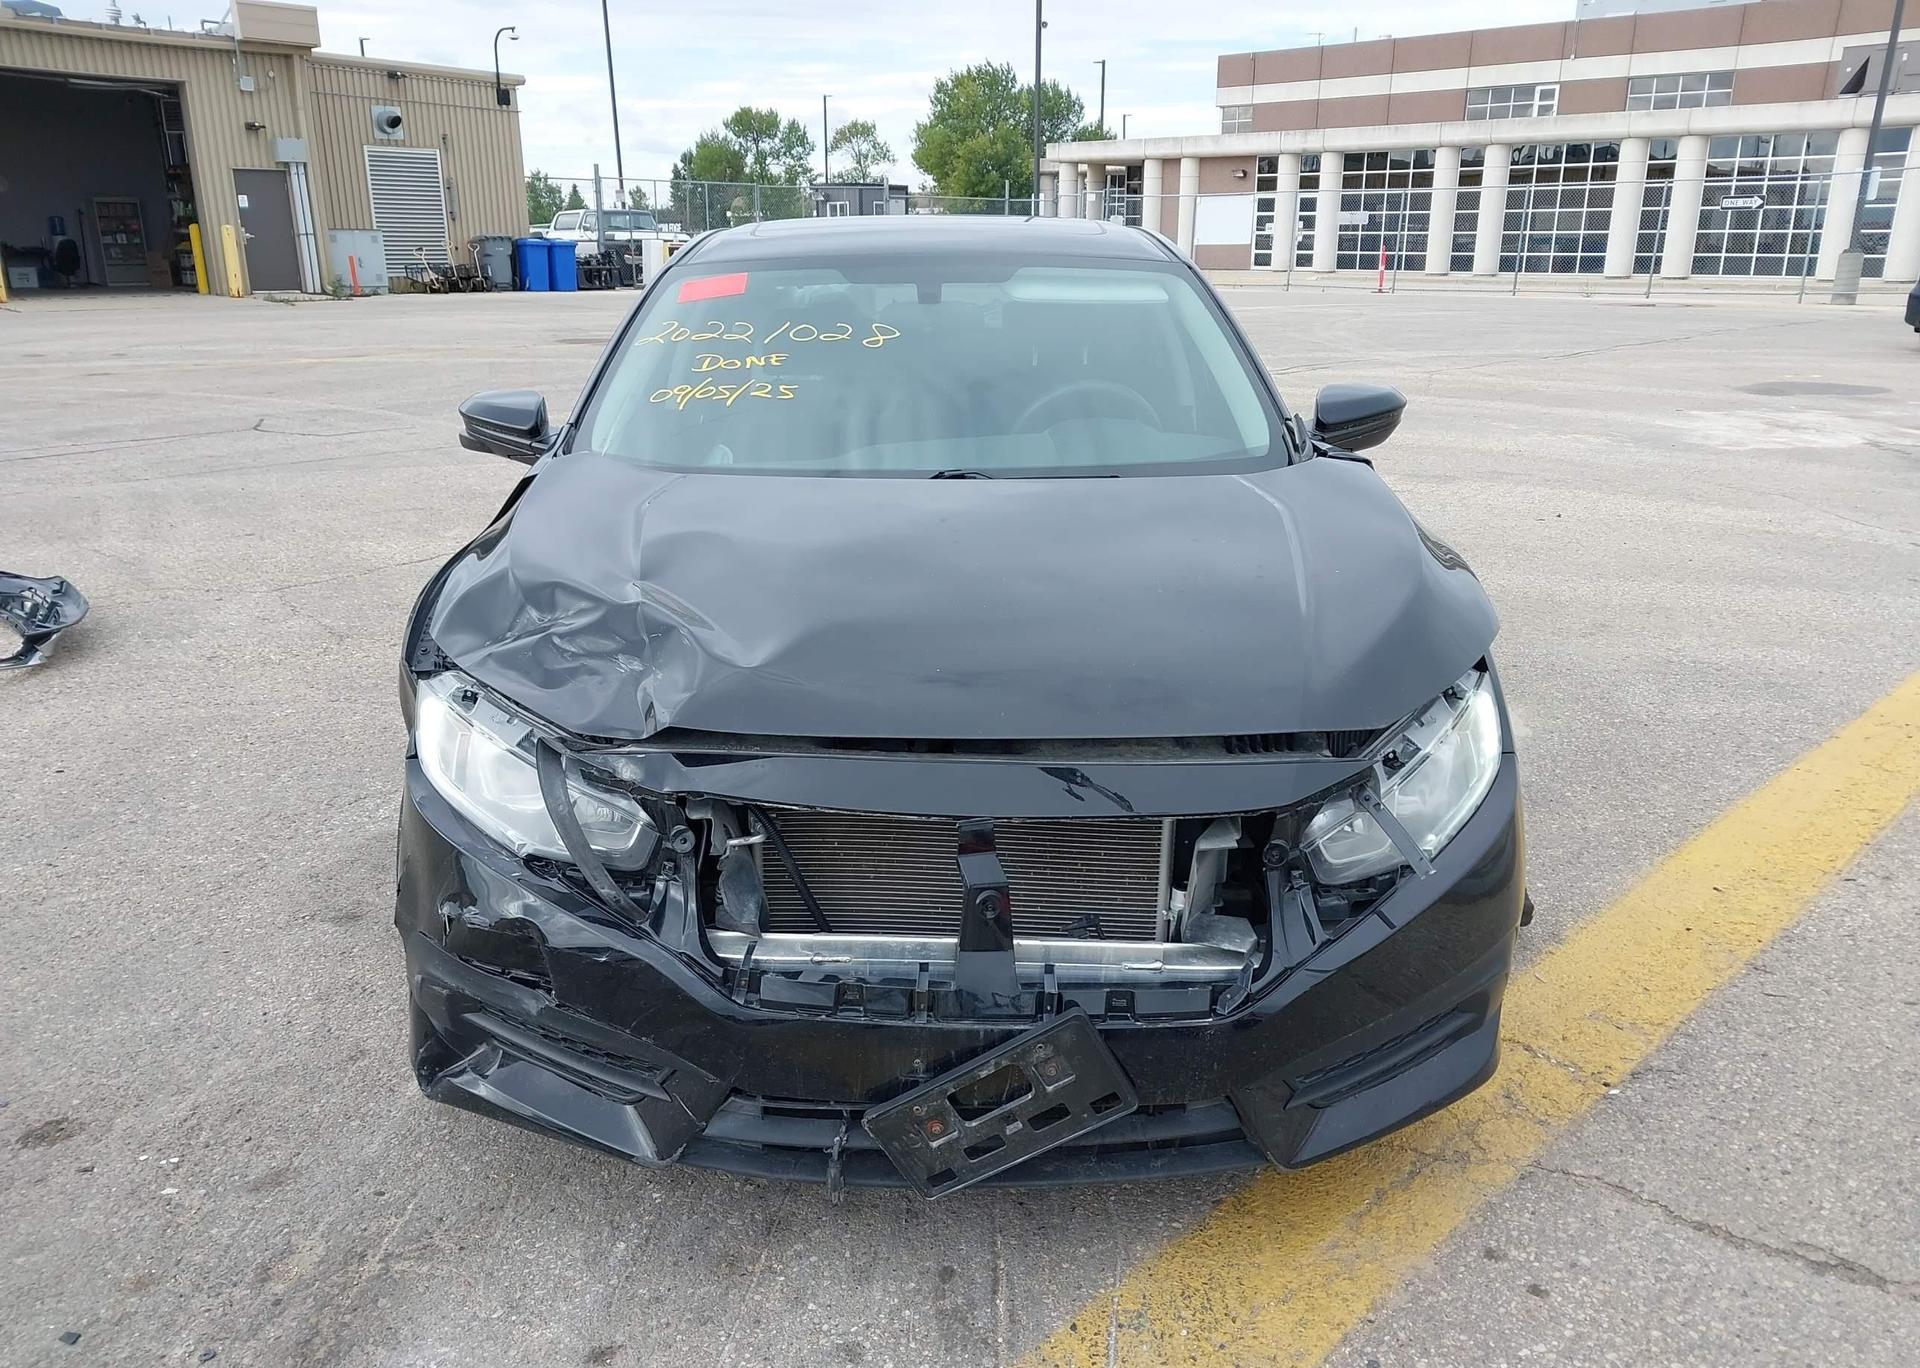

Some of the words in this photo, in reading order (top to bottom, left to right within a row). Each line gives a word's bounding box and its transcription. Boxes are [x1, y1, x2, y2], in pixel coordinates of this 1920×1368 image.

[1743, 198, 1759, 206] WAY
[691, 353, 789, 372] DONE
[649, 378, 799, 410] 09/05/25
